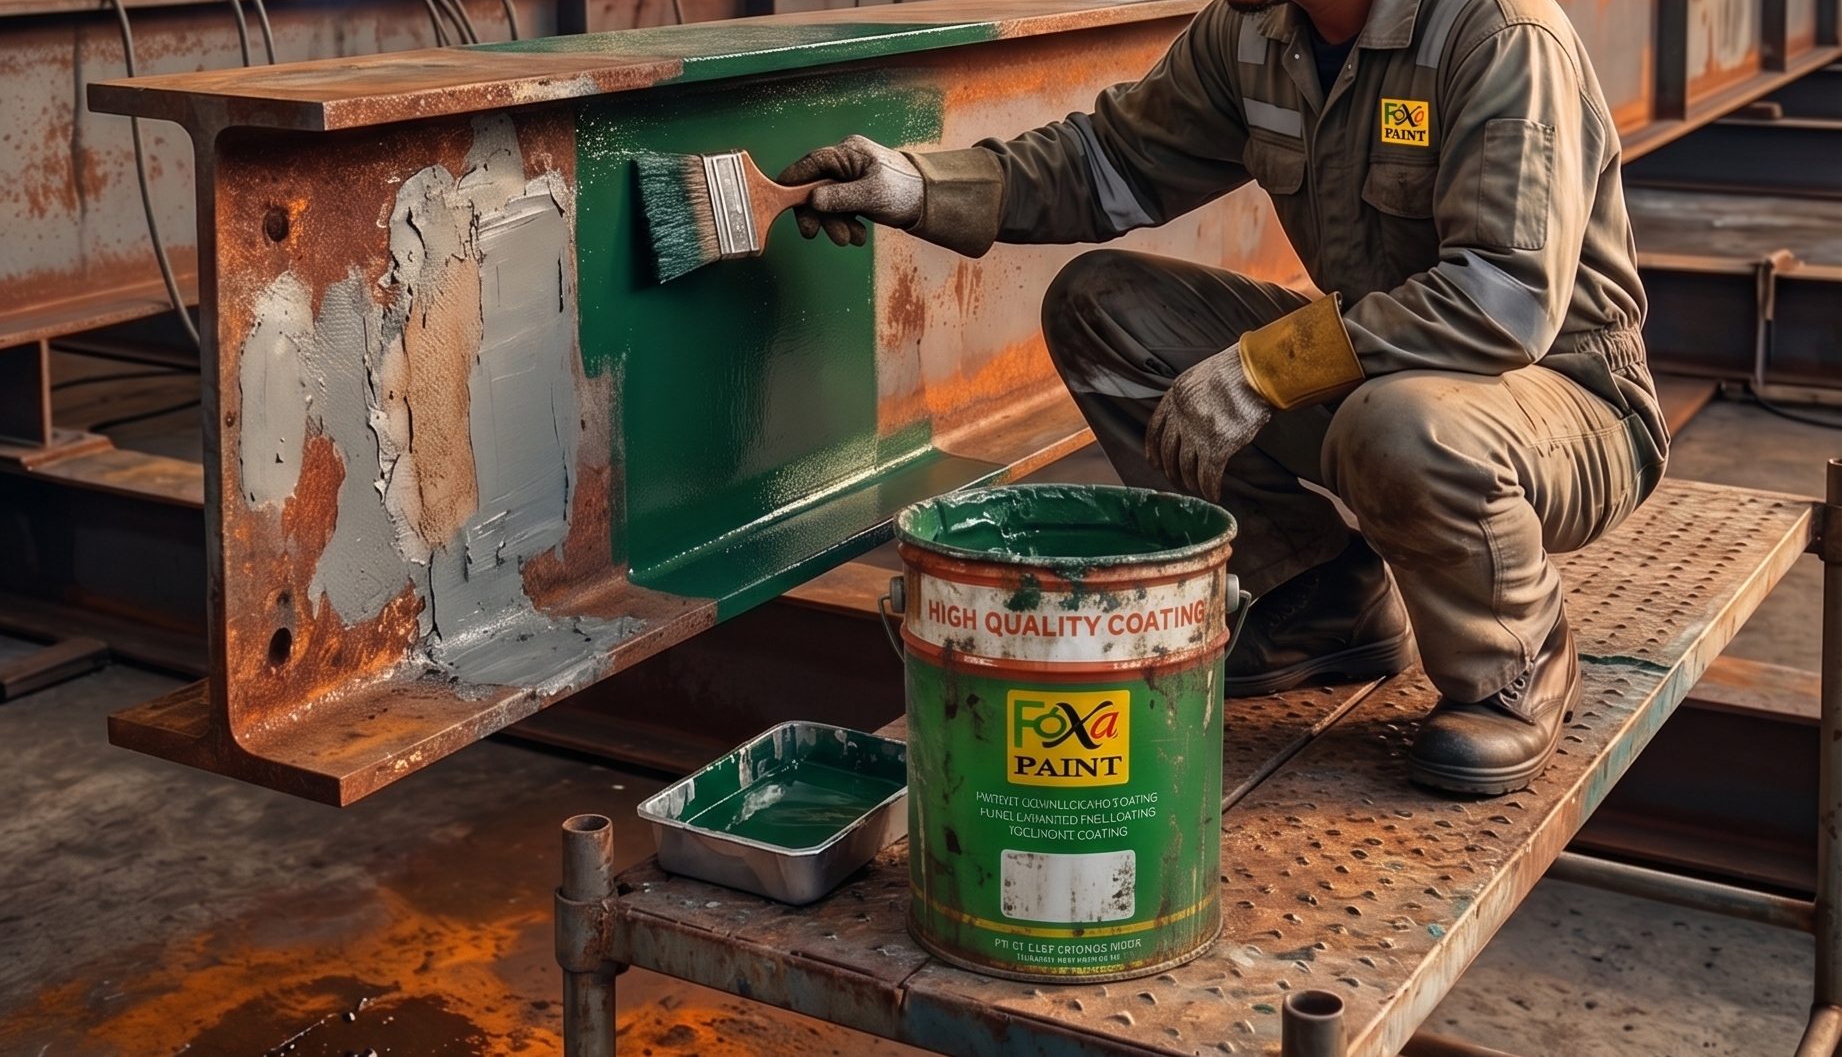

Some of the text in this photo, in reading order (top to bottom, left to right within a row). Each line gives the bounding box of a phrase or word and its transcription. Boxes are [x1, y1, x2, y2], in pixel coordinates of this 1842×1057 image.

[1385, 128, 1426, 141] PAINT
[928, 599, 1205, 637] HIGH QUALITY COATING
[1014, 756, 1122, 777] PAINT
[1078, 826, 1128, 840] COATING
